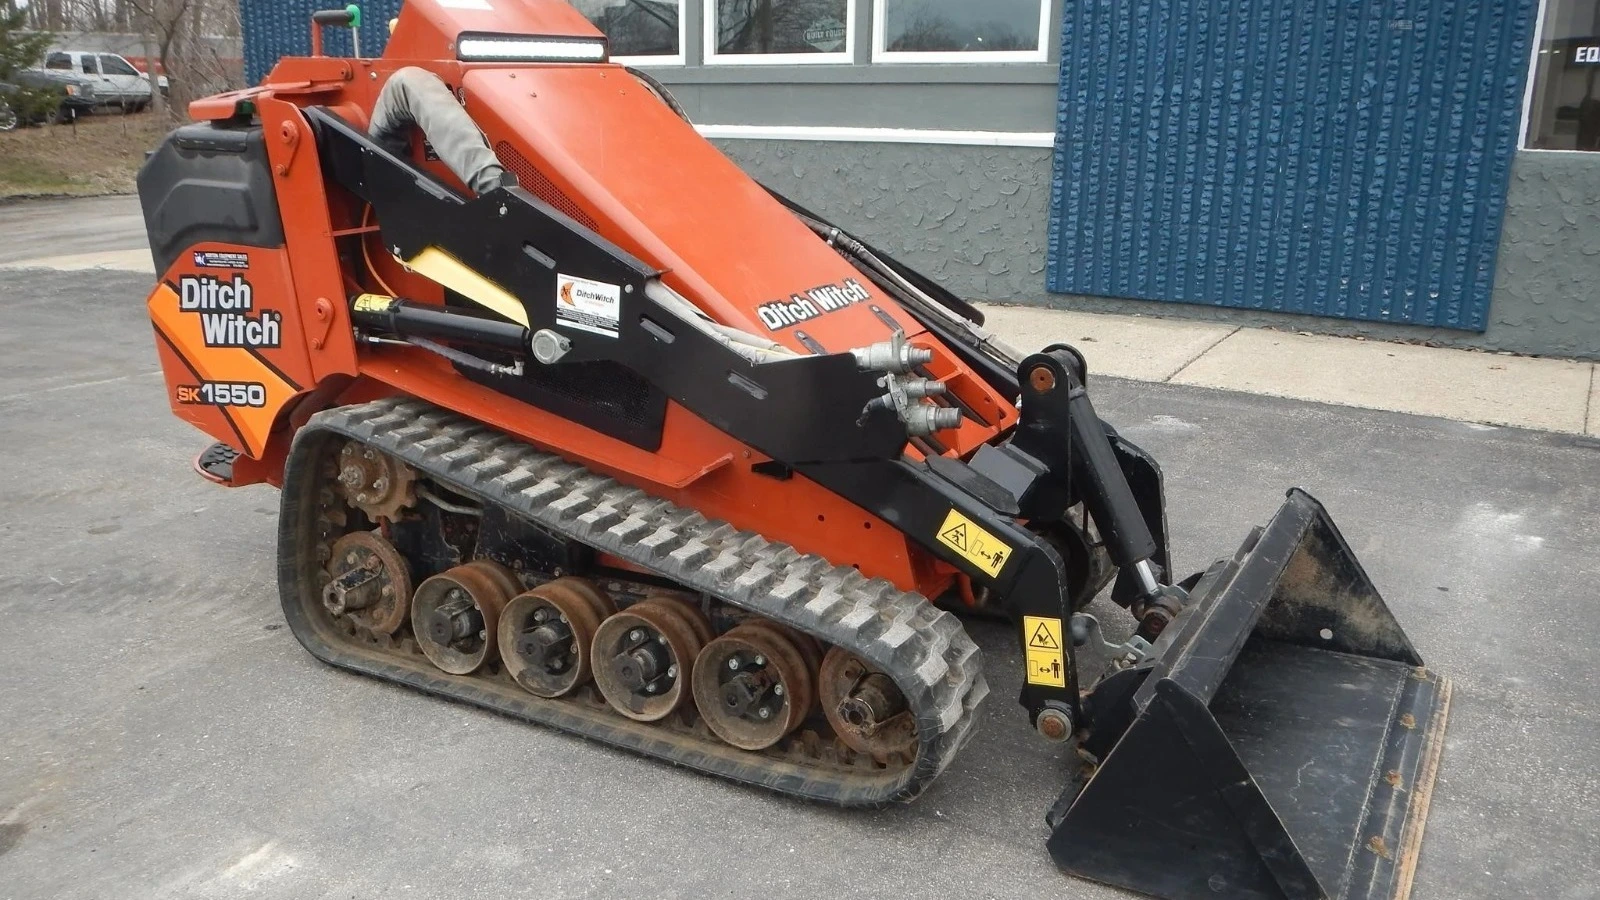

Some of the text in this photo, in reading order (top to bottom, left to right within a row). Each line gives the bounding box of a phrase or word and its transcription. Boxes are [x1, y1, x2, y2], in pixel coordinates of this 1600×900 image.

[1575, 46, 1600, 62] EQ
[180, 276, 251, 310] Ditch
[576, 289, 614, 304] DitchWitch
[757, 279, 870, 330] Ditch Witch
[202, 313, 279, 345] Witch
